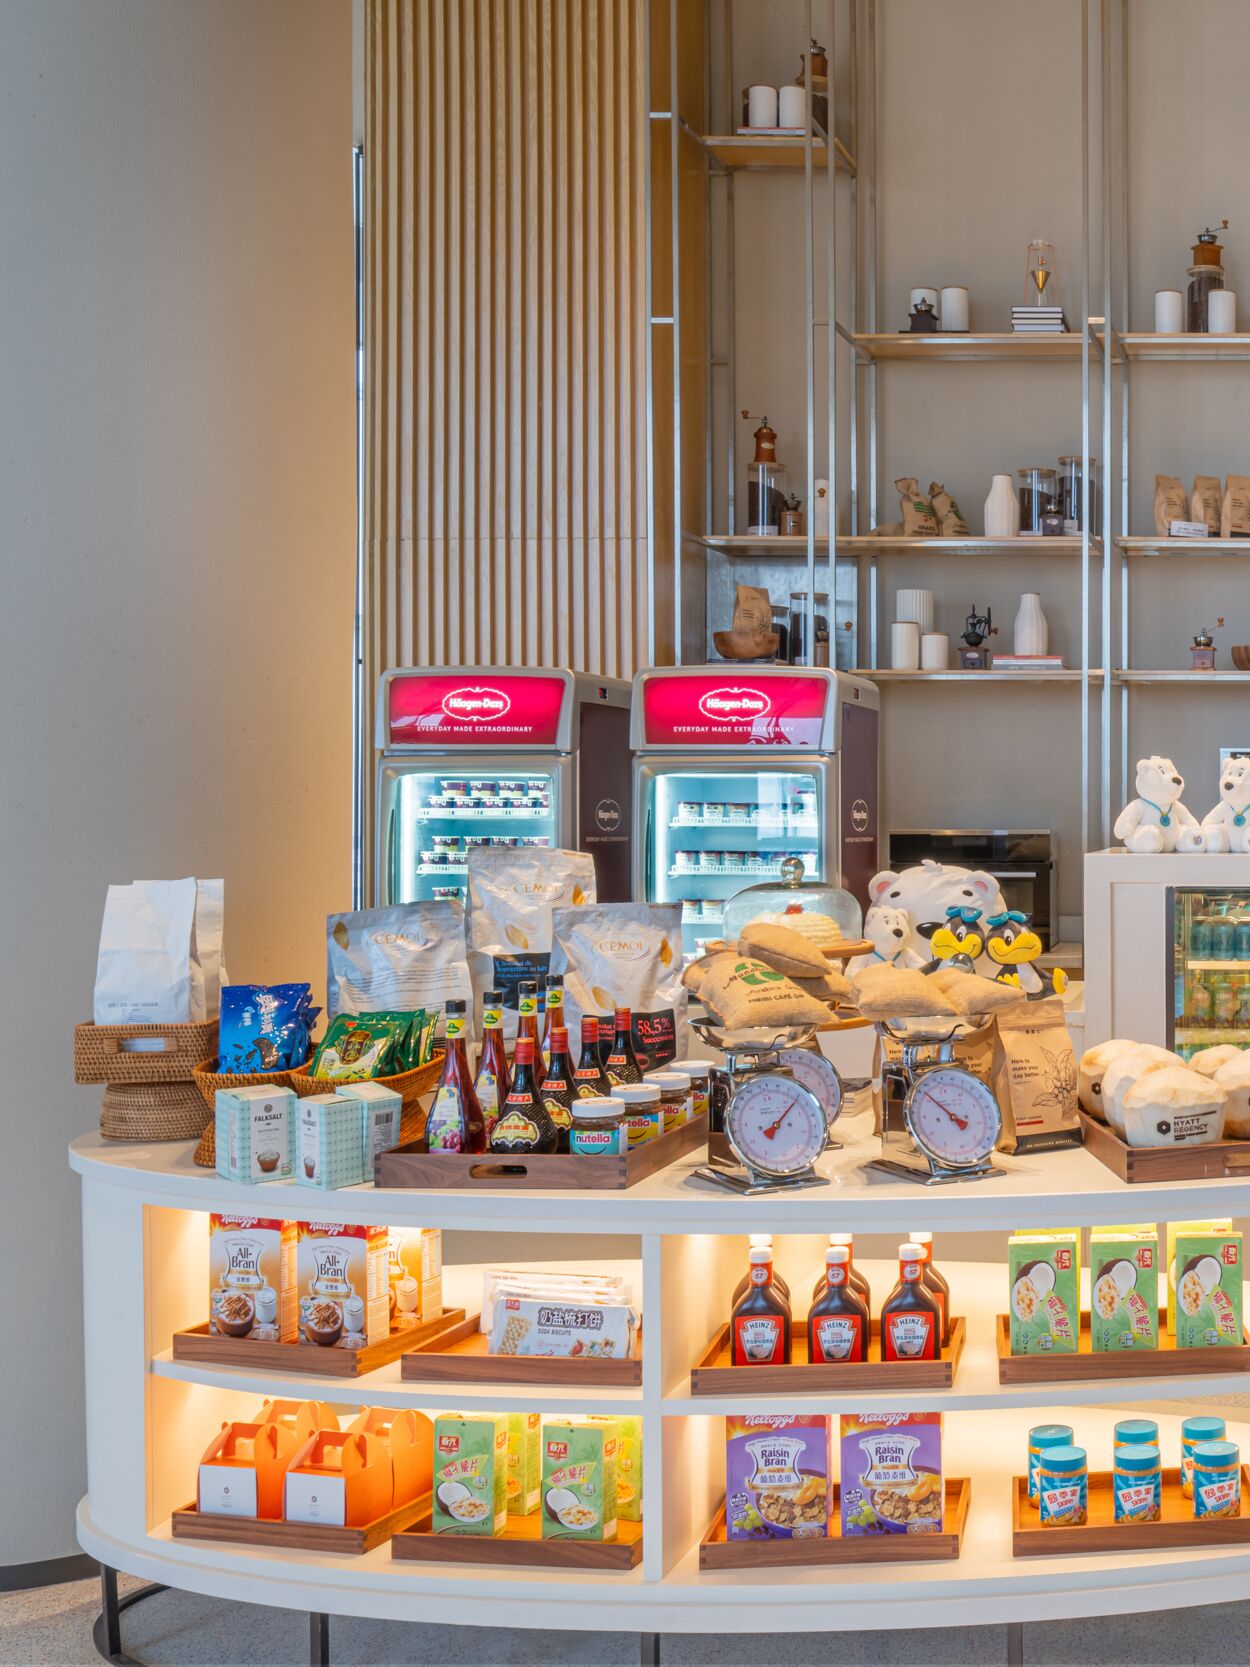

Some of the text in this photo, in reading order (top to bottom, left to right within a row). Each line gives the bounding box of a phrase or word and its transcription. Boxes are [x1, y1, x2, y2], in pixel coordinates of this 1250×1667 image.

[254, 1112, 282, 1122] FALKSALT
[627, 1118, 650, 1127] tella
[1173, 1118, 1201, 1127] HYATT
[1173, 1123, 1208, 1133] REGENCY
[575, 1132, 611, 1144] nutella
[237, 1247, 253, 1259] All-
[231, 1256, 255, 1269] Bran
[324, 1255, 341, 1267] All-
[320, 1264, 343, 1277] Bran
[539, 1308, 603, 1329] 奶盐梳打饼
[761, 1448, 790, 1459] Raisin
[875, 1446, 904, 1456] Raisin
[764, 1457, 787, 1467] Bran
[878, 1454, 901, 1464] Bran
[1131, 1497, 1148, 1506] SKIPPY
[1214, 1492, 1231, 1502] SKIPPY
[1056, 1498, 1074, 1508] SKIPPY
